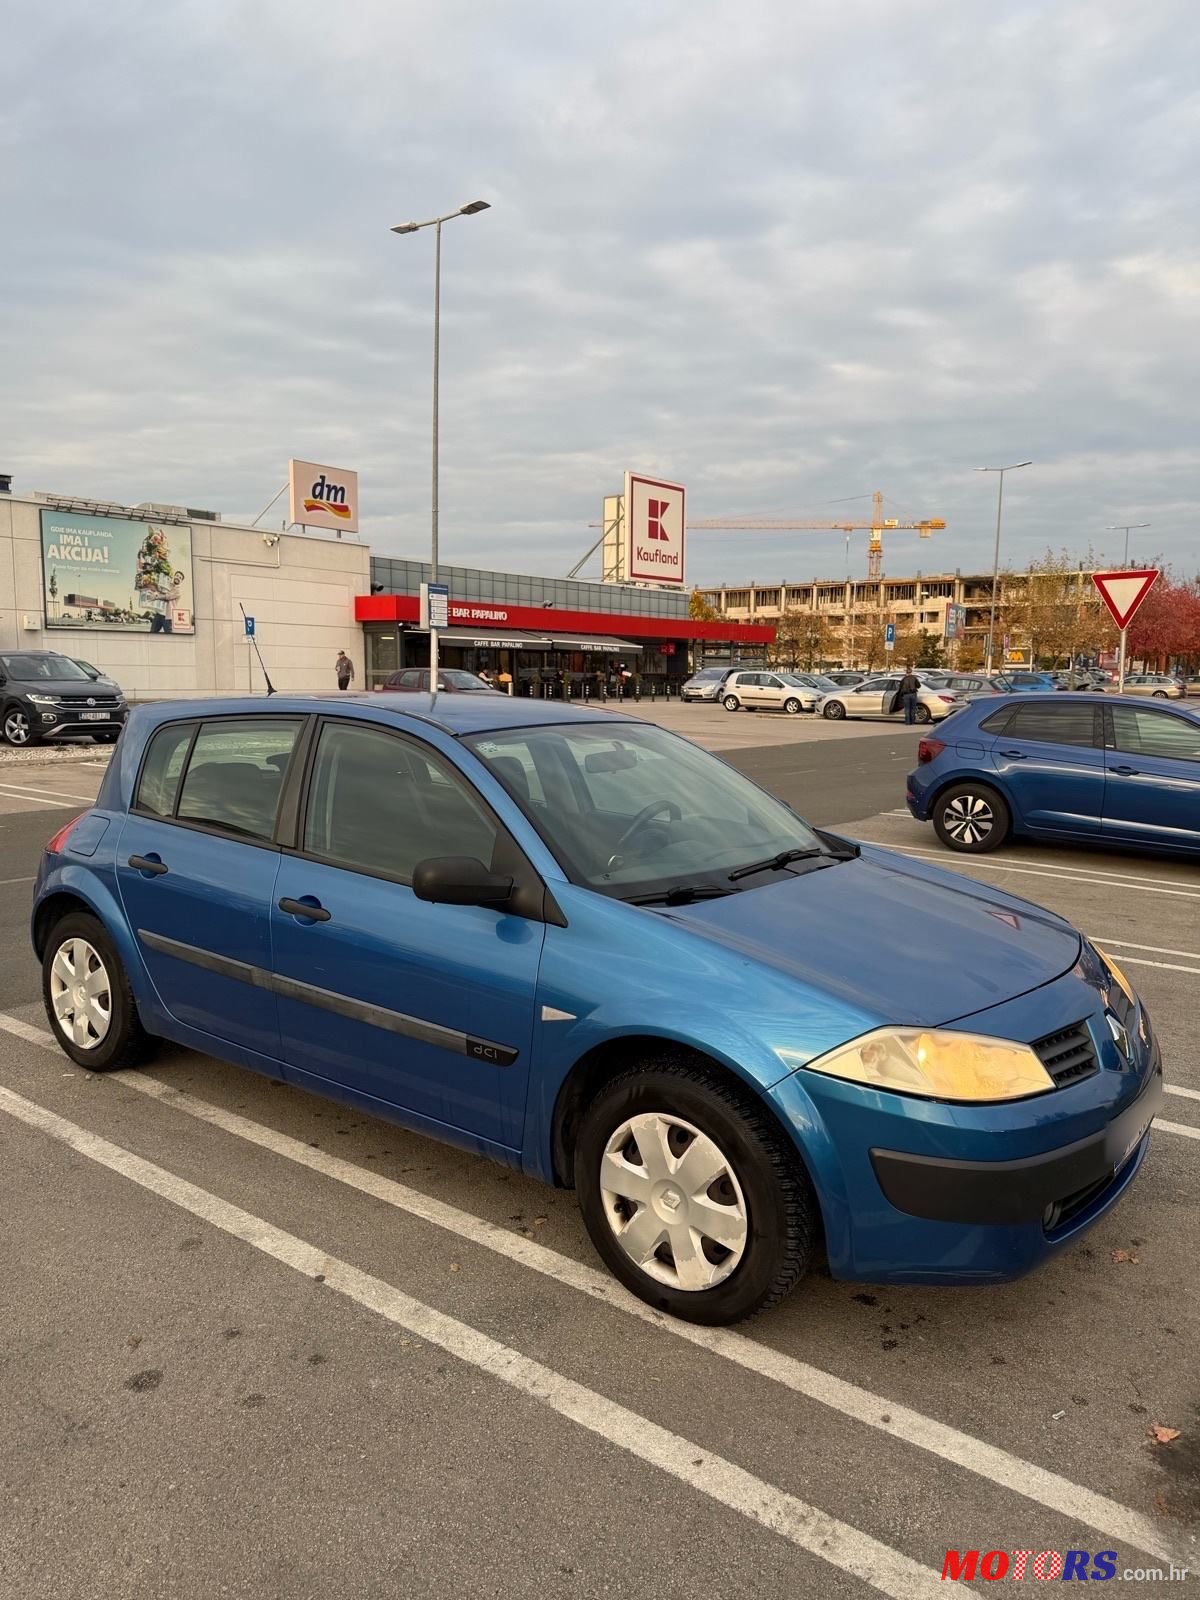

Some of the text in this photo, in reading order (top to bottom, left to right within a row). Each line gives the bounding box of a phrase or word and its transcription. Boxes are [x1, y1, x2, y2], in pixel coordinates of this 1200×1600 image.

[311, 475, 346, 504] dm
[648, 498, 671, 542] K
[60, 534, 88, 546] IMA I
[47, 543, 109, 564] AKCIJA!
[636, 546, 679, 566] Kaufland
[452, 608, 470, 618] BAR
[471, 608, 508, 621] PAPALINO
